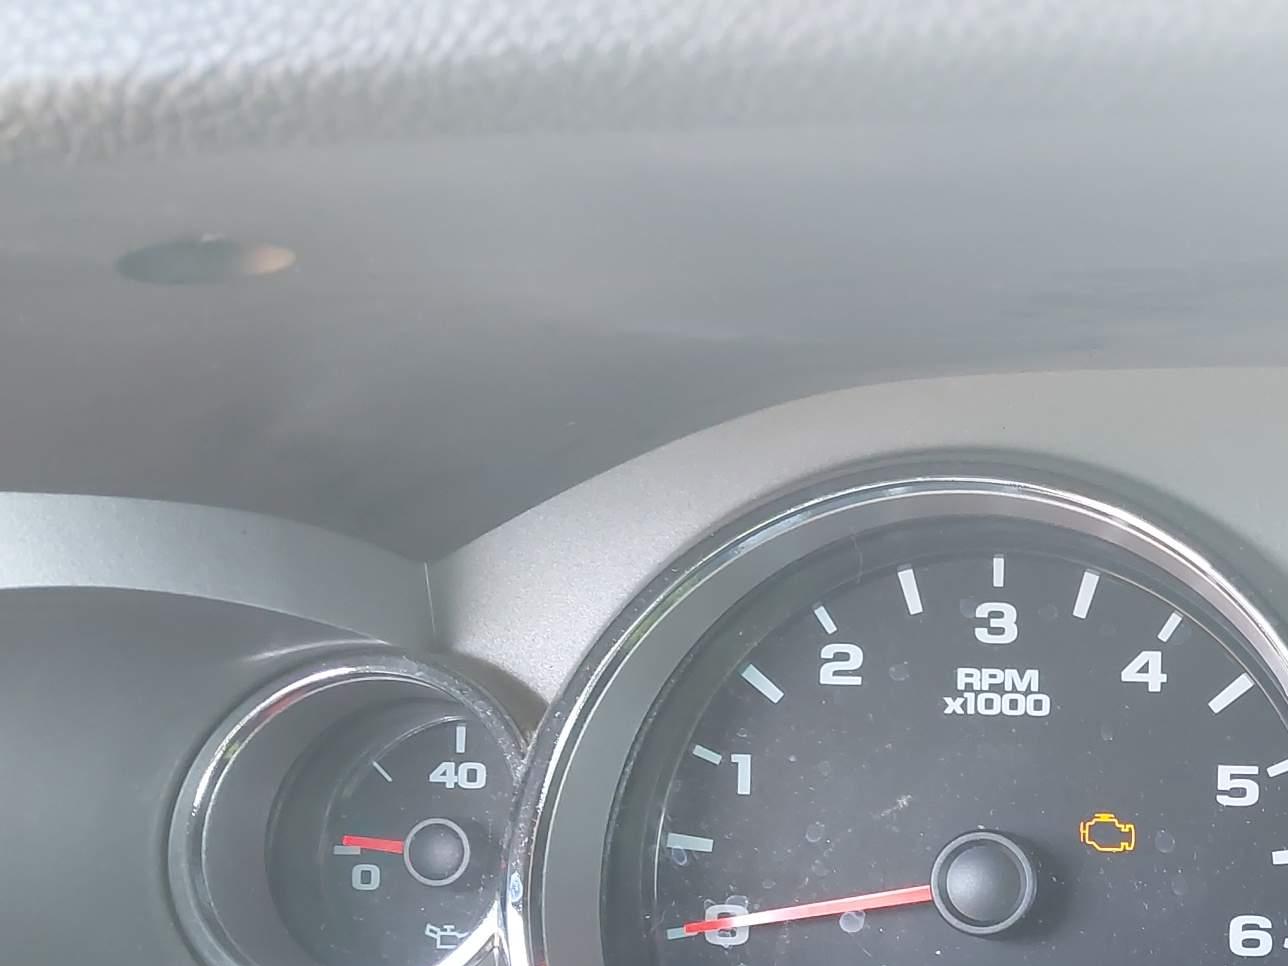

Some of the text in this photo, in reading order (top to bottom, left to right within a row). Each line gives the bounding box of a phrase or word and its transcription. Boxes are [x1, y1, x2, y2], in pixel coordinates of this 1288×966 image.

[974, 602, 1018, 644] 3
[819, 643, 864, 685] 2
[957, 667, 1039, 692] RPM
[1120, 651, 1167, 692] 4
[943, 692, 1051, 716] x1000
[429, 762, 487, 789] 40
[730, 754, 752, 795] 1
[1216, 764, 1260, 807] 5
[351, 864, 381, 891] 0
[1228, 915, 1273, 957] 6
